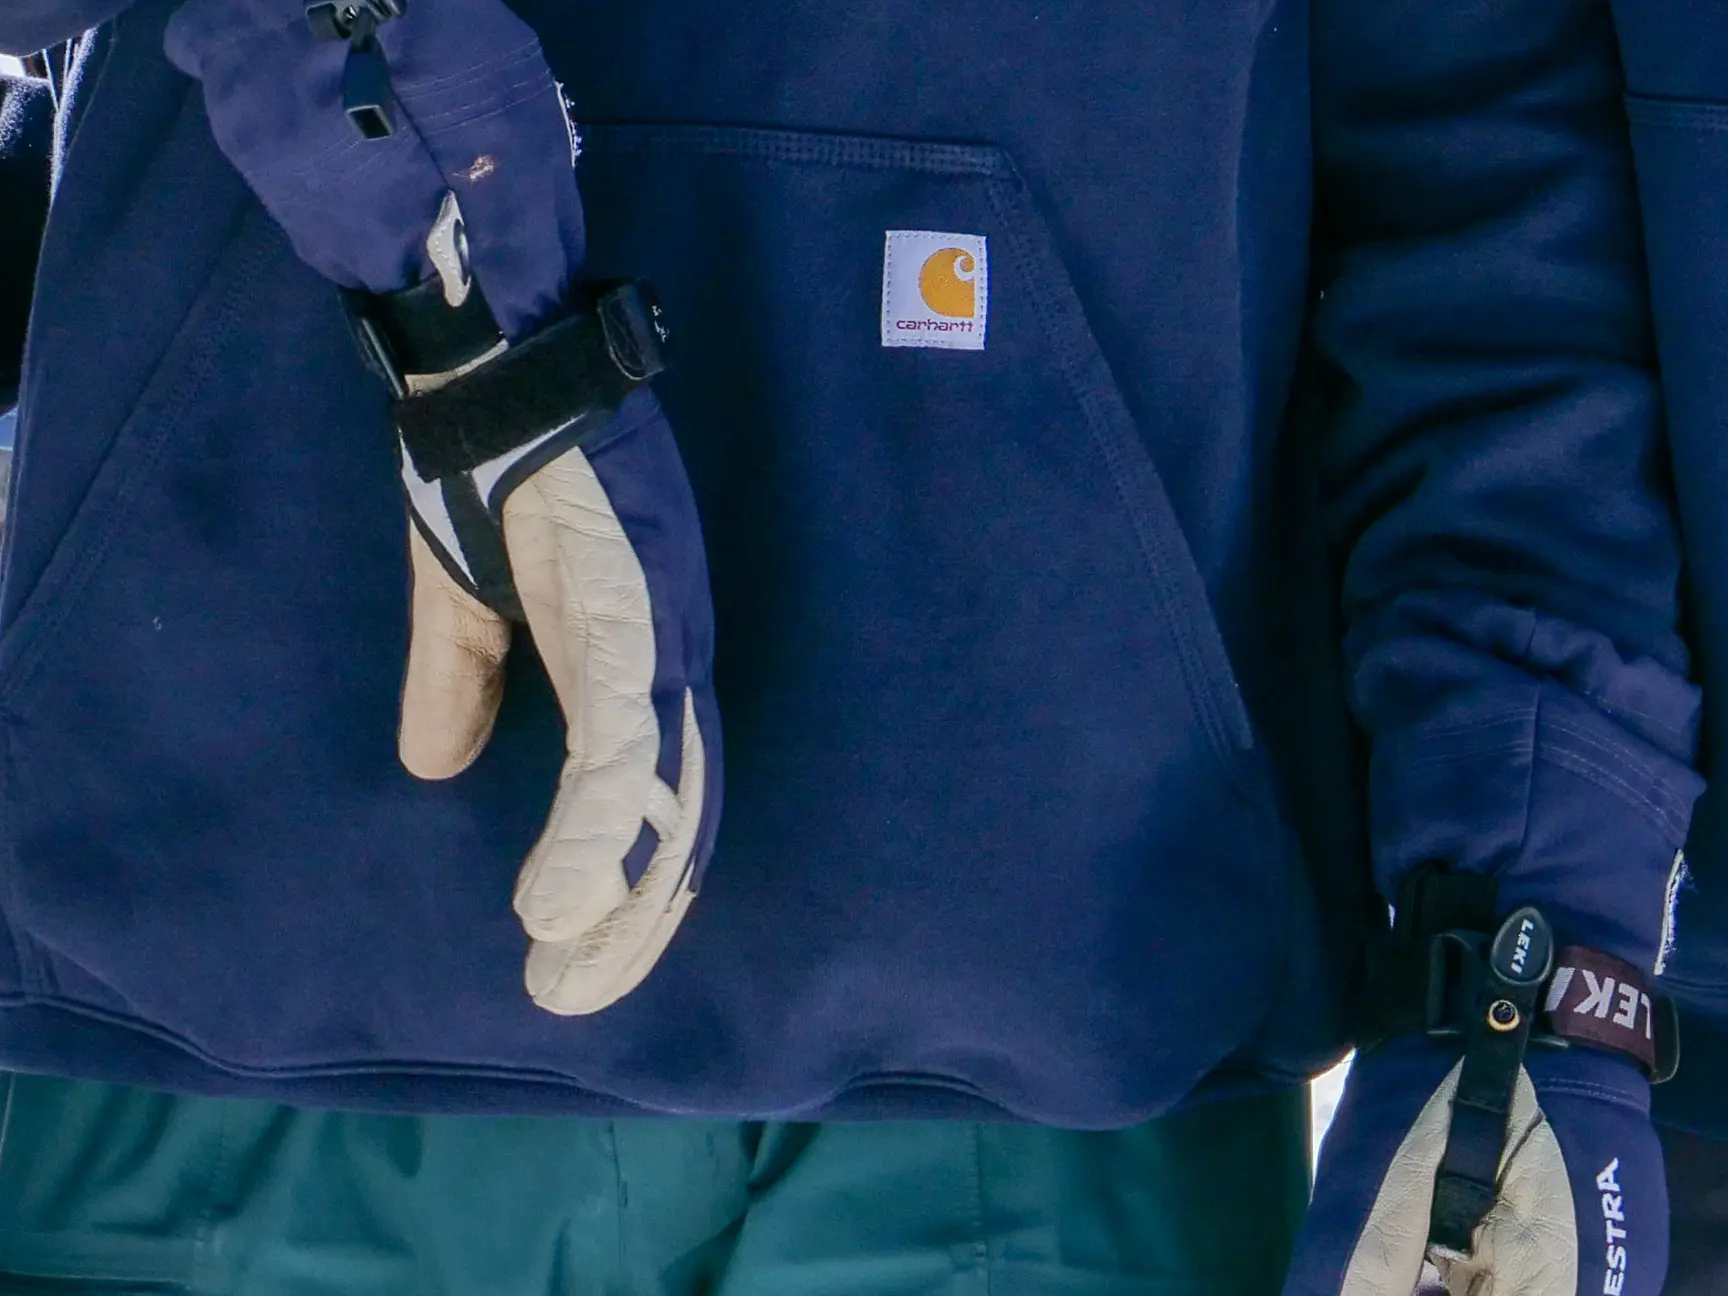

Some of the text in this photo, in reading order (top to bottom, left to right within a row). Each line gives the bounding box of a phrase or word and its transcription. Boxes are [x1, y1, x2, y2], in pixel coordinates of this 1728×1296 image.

[896, 319, 974, 333] carhartt
[1510, 919, 1534, 974] LEKI
[1543, 967, 1652, 1040] LEKI
[1596, 1157, 1627, 1296] ESTRA
